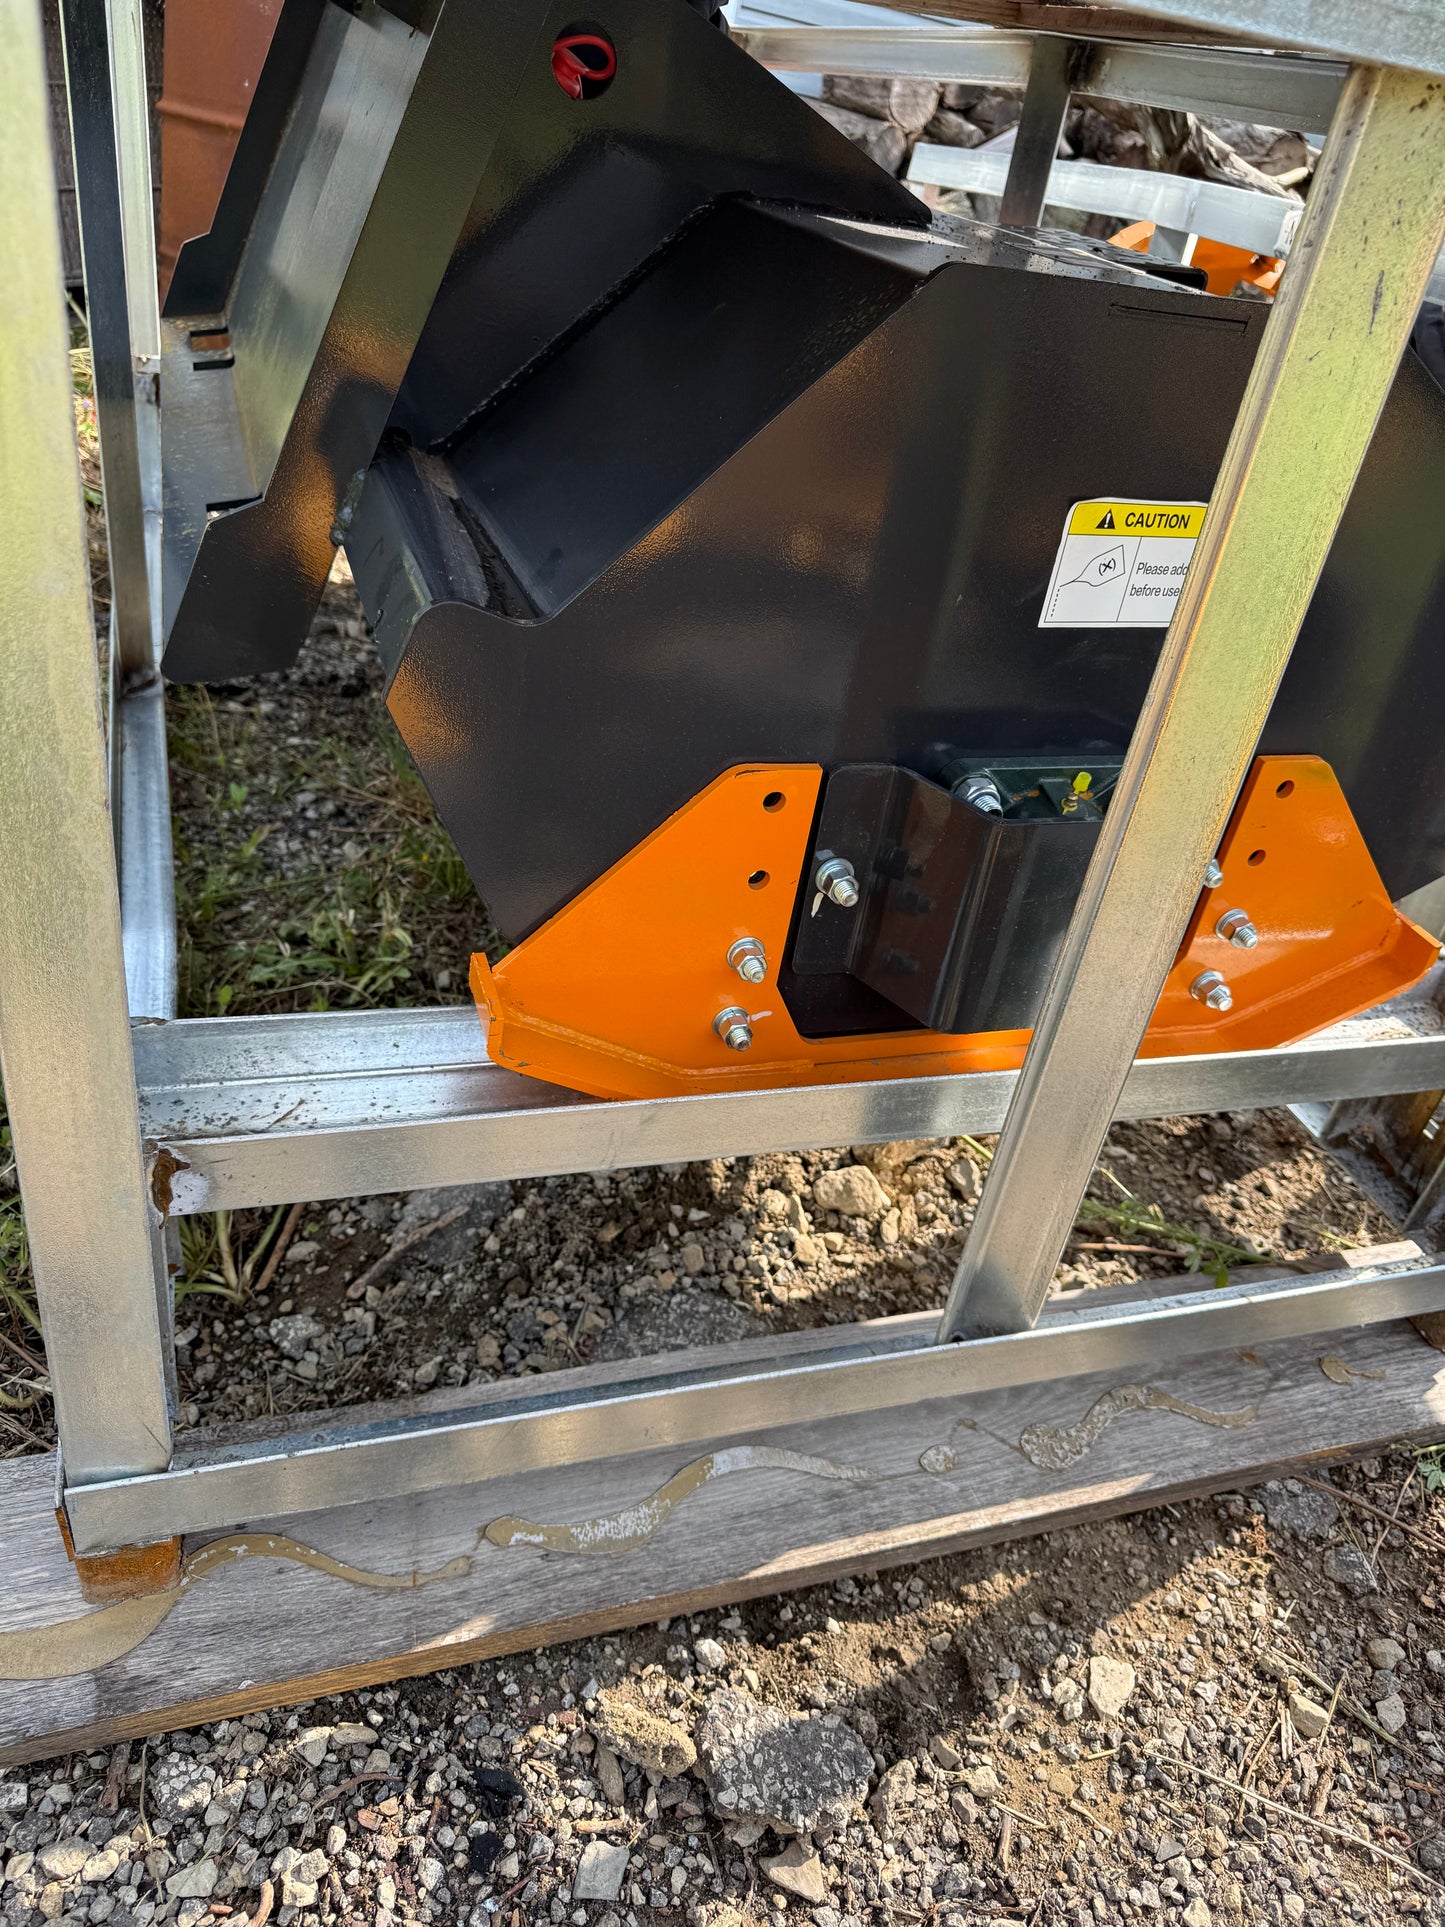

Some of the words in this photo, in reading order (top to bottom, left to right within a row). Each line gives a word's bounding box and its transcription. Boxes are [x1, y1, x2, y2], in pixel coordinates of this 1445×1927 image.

[1124, 512, 1191, 529] CAUTION
[1136, 562, 1170, 575] Please
[1129, 583, 1161, 597] before
[1162, 587, 1180, 597] use
